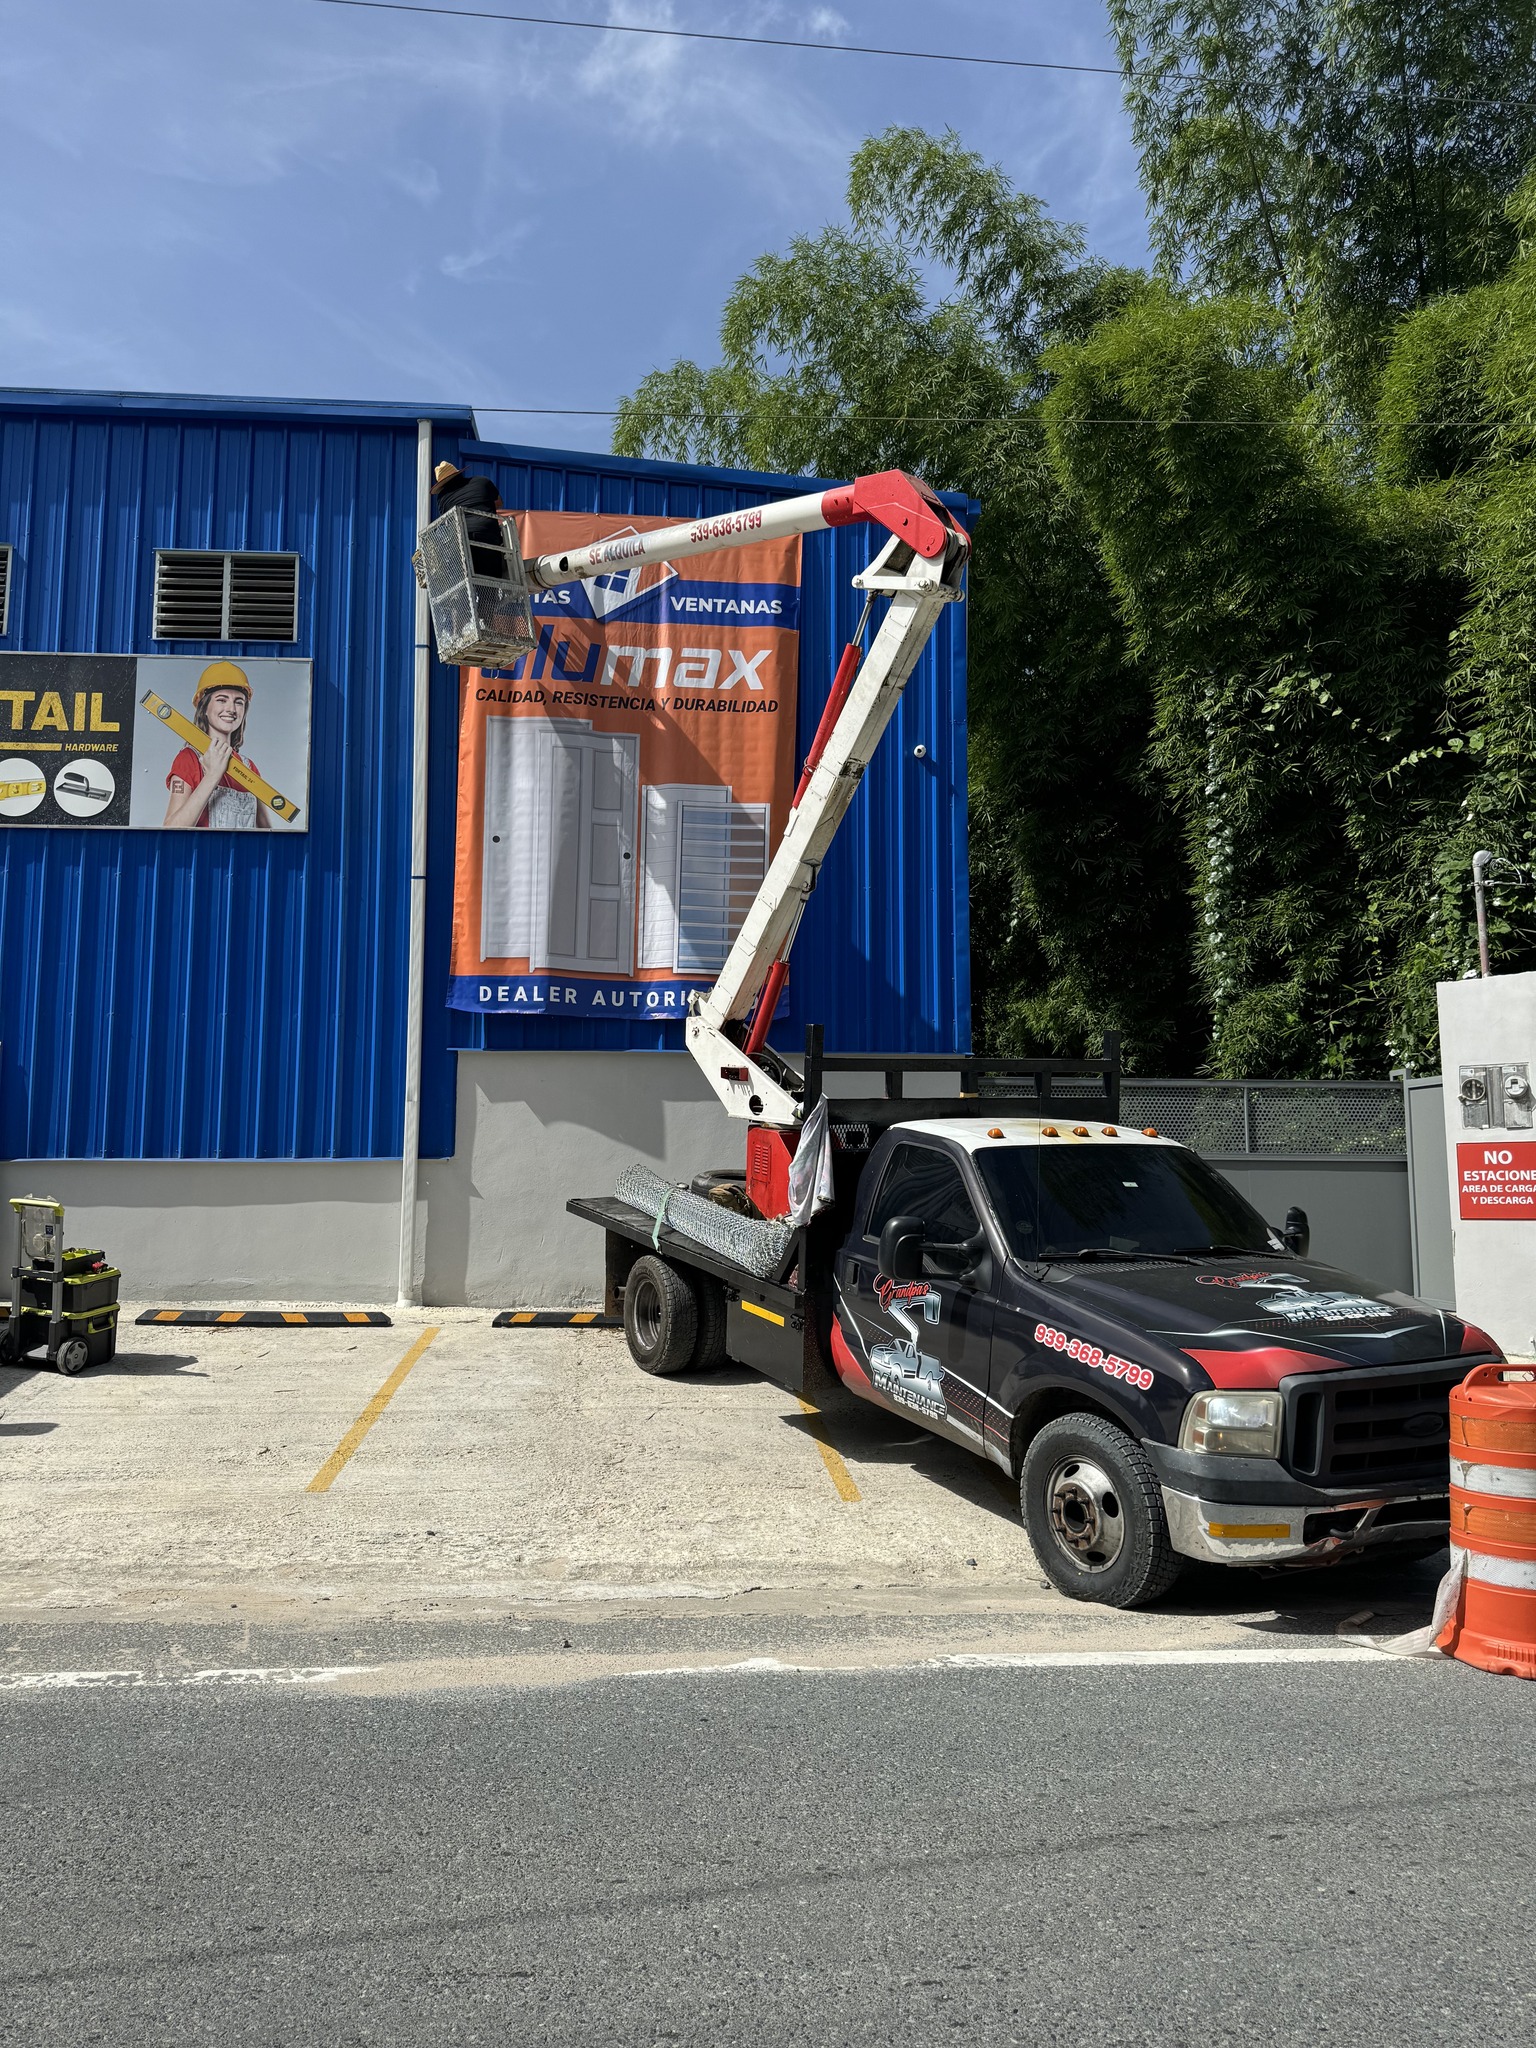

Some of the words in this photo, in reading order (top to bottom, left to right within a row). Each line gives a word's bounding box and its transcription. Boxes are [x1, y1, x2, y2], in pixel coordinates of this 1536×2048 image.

[589, 549, 602, 565] SE
[603, 538, 646, 563] ALQUILA
[670, 596, 783, 615] VENTANAS
[475, 688, 547, 706] CALIDAD,
[552, 690, 656, 712] RESISTENCIA
[661, 697, 670, 711] Y
[673, 697, 779, 713] DURABILIDAD
[0, 690, 120, 732] TAIL
[64, 743, 119, 752] HARDWARE
[479, 985, 577, 1004] DEALER
[591, 990, 686, 1008] AUTORI
[1483, 1150, 1513, 1165] NO
[1463, 1169, 1536, 1181] ESTACIONE
[1461, 1184, 1488, 1193] AREA
[1489, 1184, 1504, 1193] DE
[1471, 1196, 1478, 1205] Y
[1480, 1196, 1534, 1205] DESCARGA
[1035, 1323, 1154, 1390] 939-368-5799
